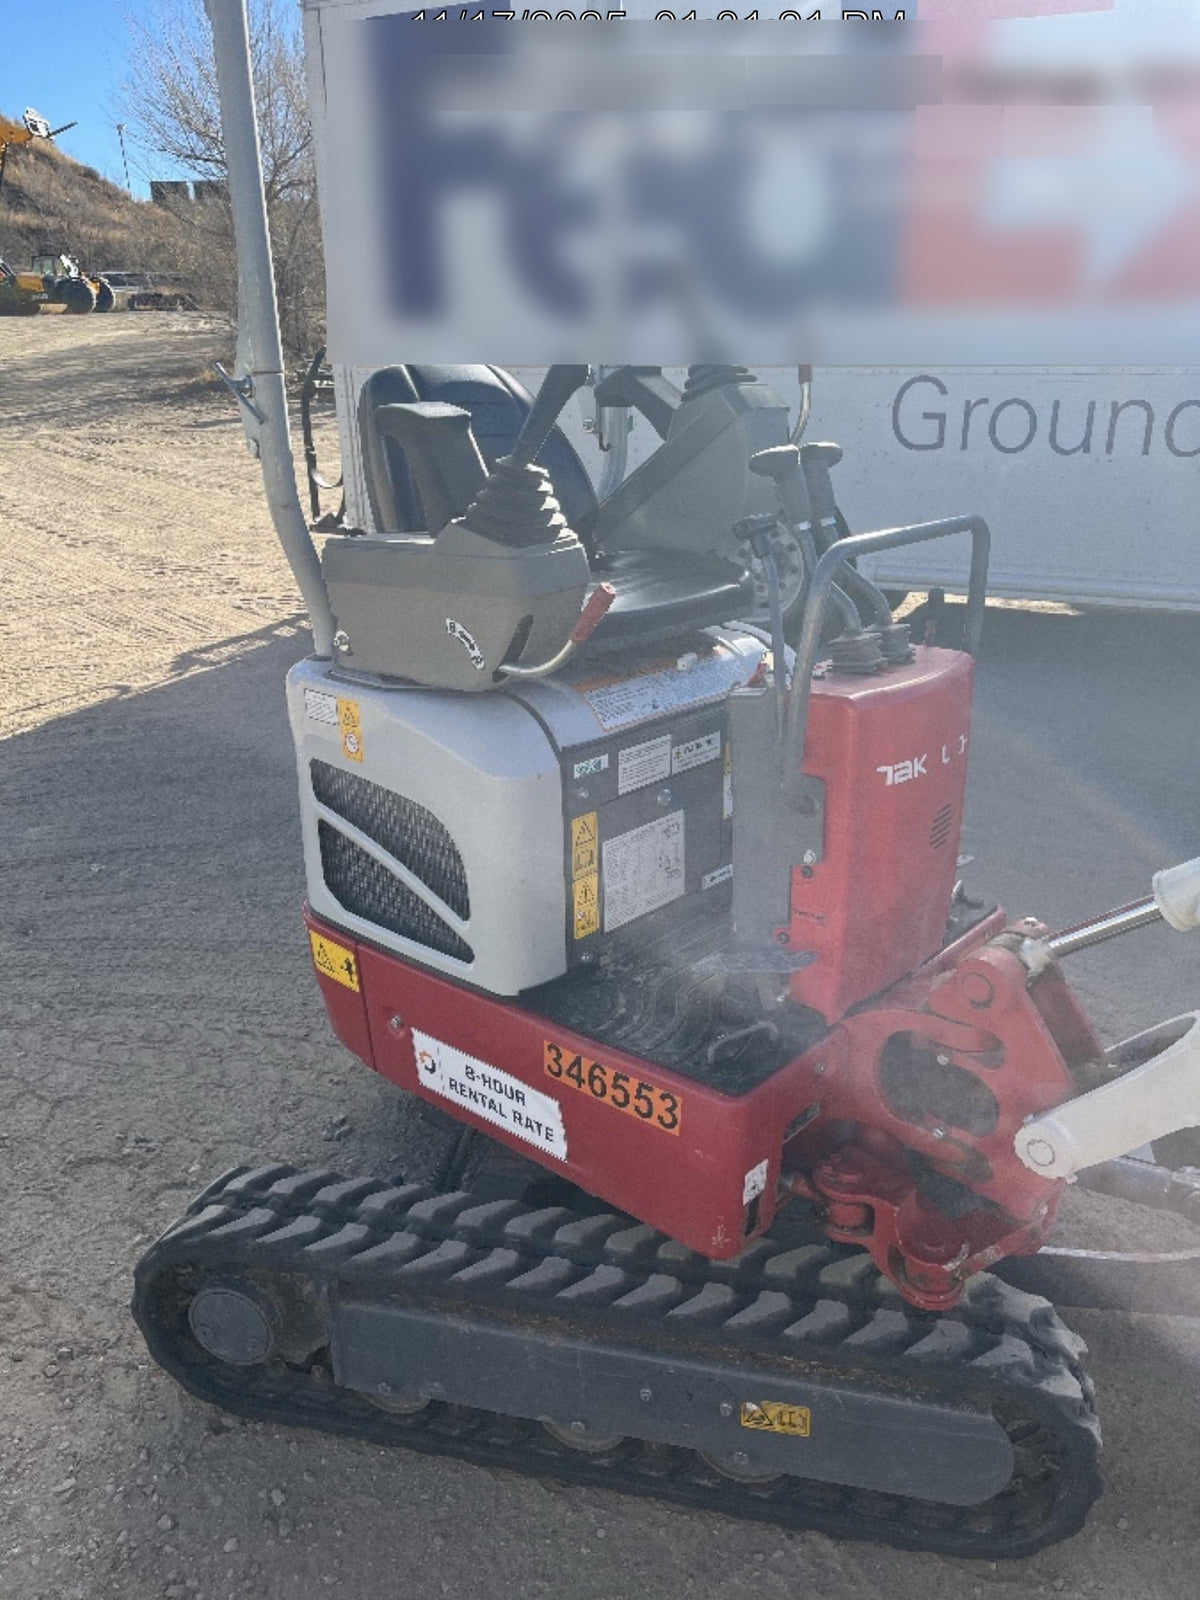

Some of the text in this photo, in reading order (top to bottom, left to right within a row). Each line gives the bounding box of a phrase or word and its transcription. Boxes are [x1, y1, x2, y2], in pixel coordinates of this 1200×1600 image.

[449, 1077, 554, 1142] RENTAL RATE
[546, 1043, 678, 1130] 346553
